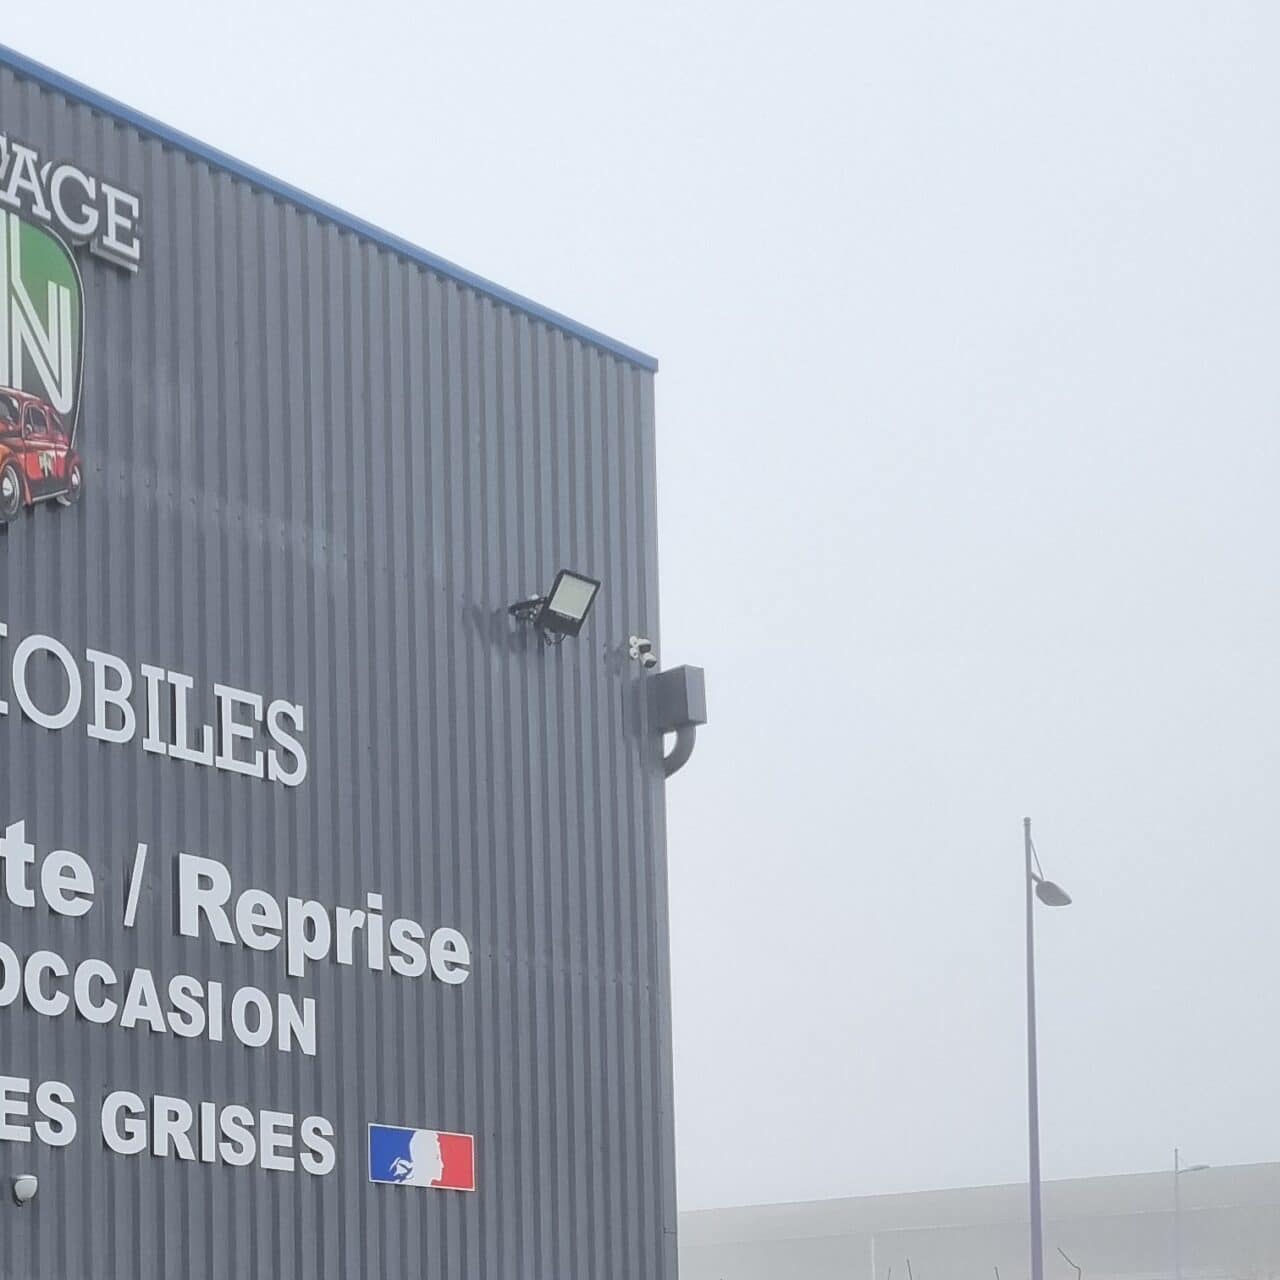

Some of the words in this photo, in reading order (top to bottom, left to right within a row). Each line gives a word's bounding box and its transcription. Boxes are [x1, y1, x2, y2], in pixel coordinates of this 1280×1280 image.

[124, 842, 148, 928] /
[179, 852, 471, 985] Reprise
[101, 1090, 337, 1176] GRISES
